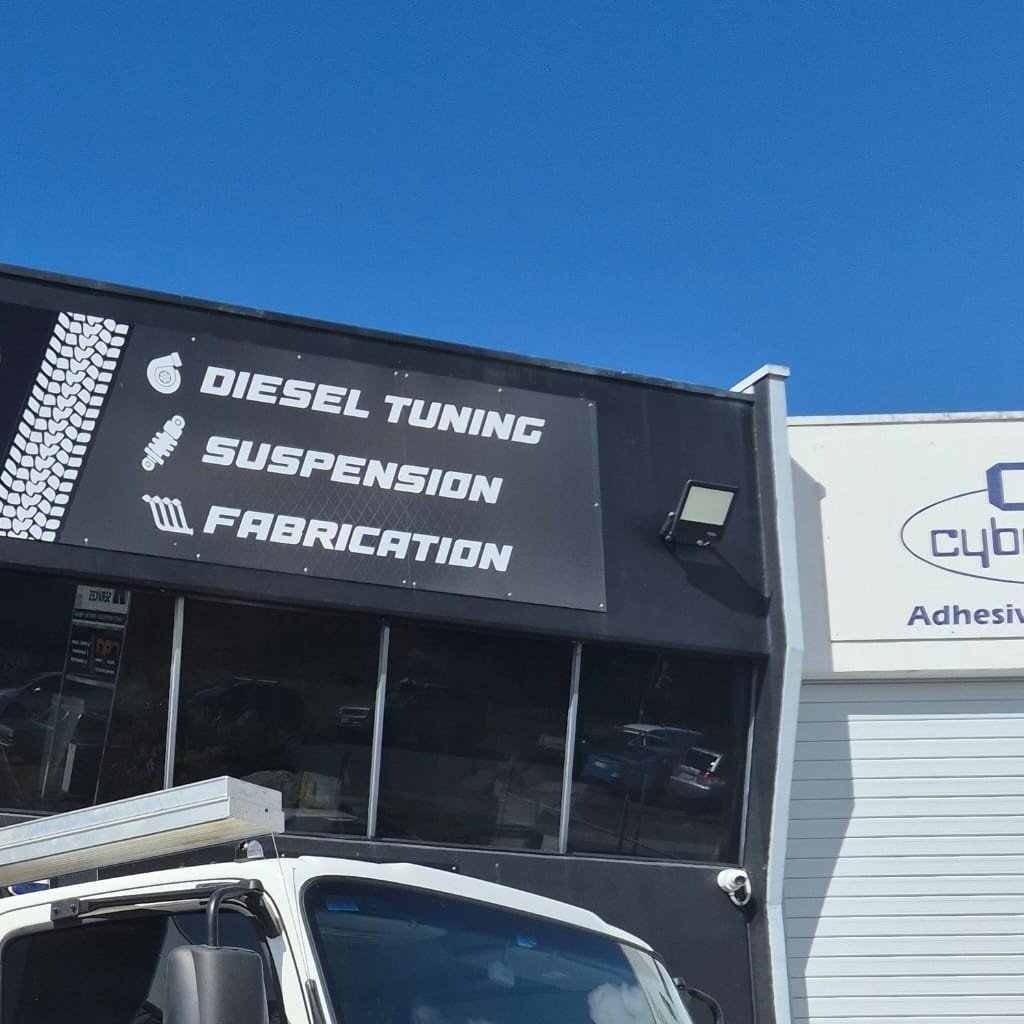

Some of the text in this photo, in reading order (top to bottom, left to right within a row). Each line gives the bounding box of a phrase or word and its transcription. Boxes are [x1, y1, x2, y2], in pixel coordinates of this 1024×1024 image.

[199, 365, 546, 445] DIESEL TUNING
[202, 436, 504, 504] SUSPENSION
[202, 505, 514, 573] FABRICATION
[930, 516, 1024, 568] cyb
